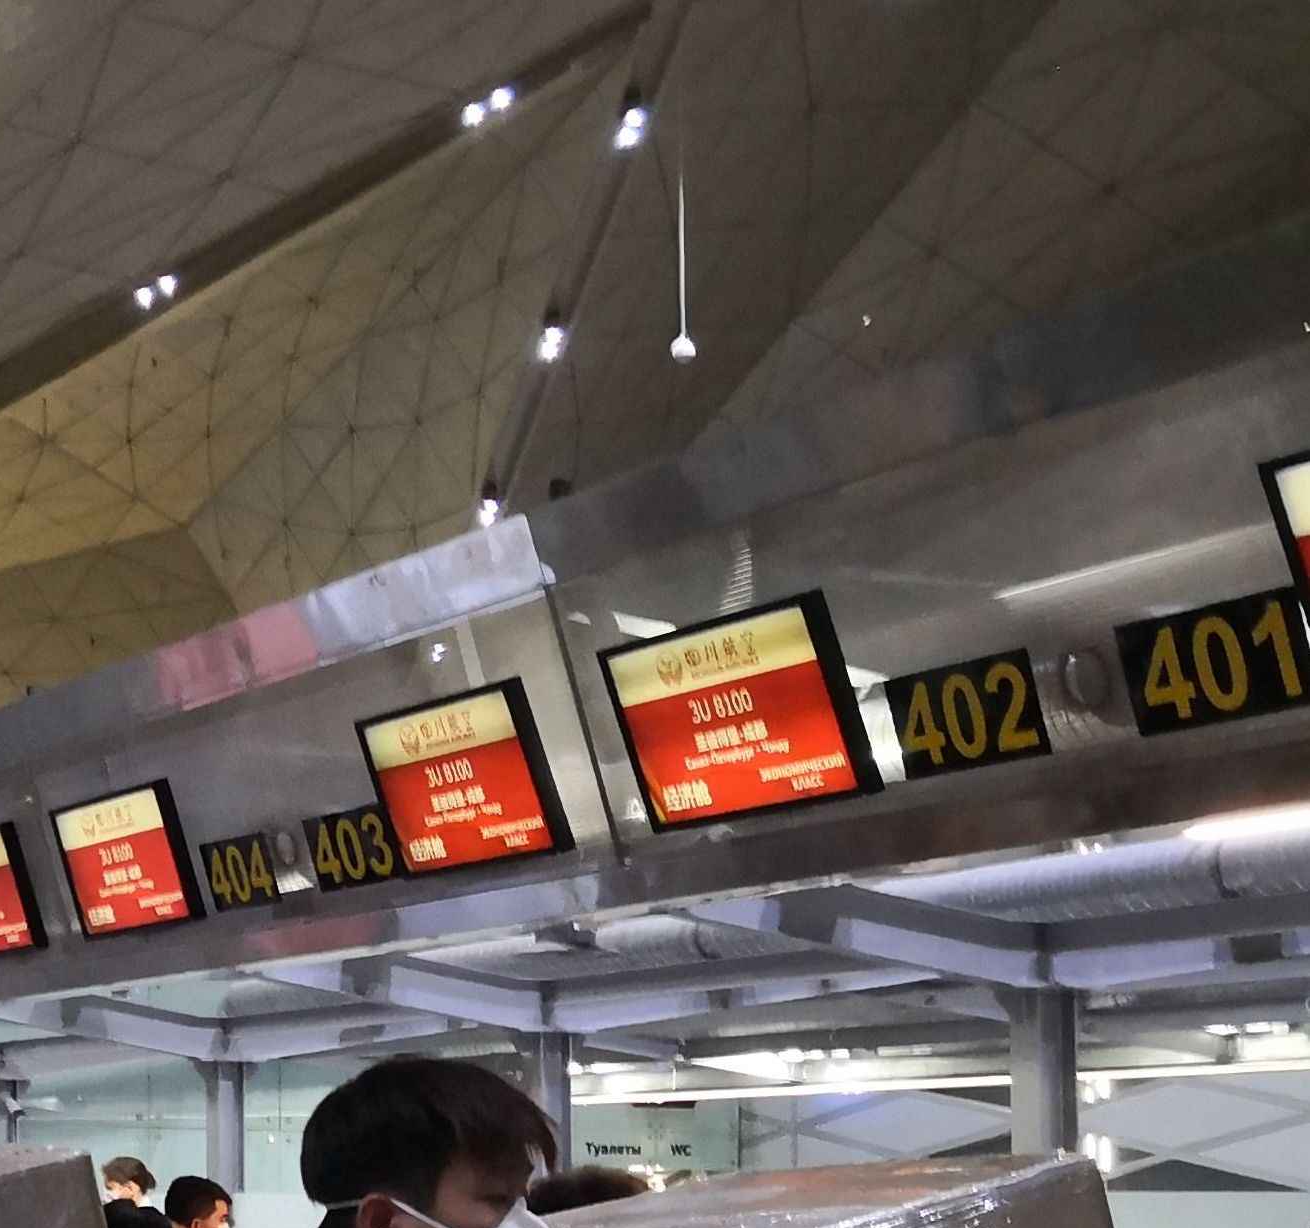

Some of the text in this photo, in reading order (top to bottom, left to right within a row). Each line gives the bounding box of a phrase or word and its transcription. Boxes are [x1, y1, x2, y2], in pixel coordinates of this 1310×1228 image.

[1144, 601, 1303, 719] 401
[688, 687, 753, 725] 3U 8100
[902, 661, 1040, 765] 402
[424, 757, 474, 788] 3U 8100
[211, 813, 393, 904] 404 403
[585, 1142, 692, 1157] Туалеты WC
